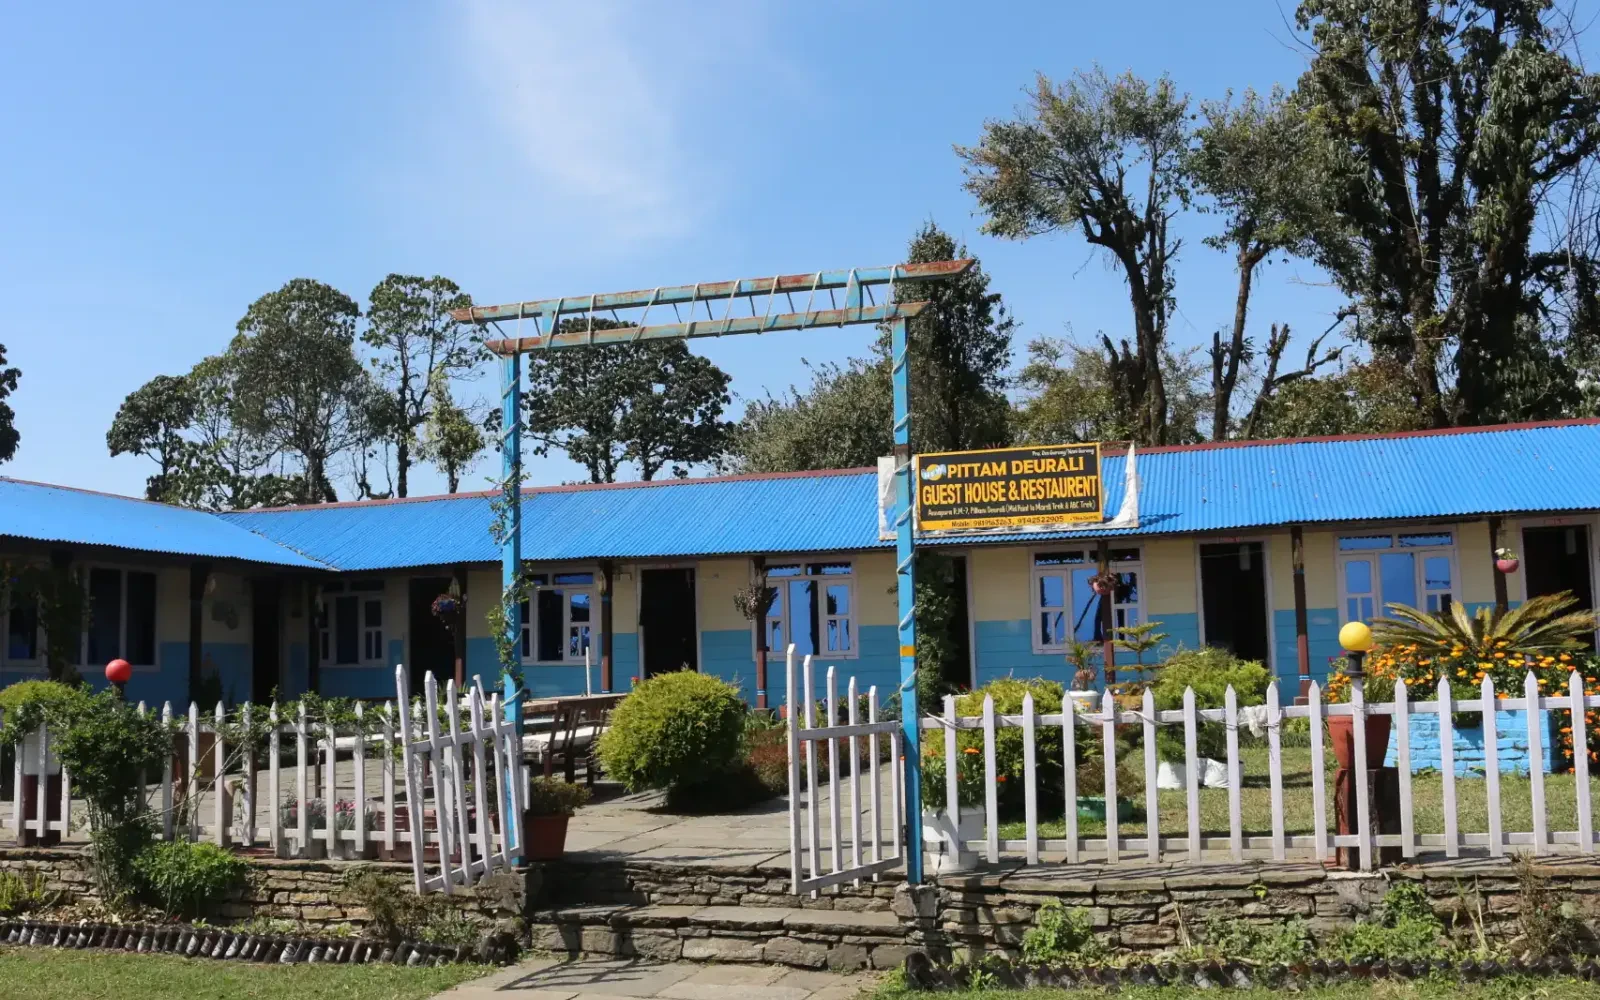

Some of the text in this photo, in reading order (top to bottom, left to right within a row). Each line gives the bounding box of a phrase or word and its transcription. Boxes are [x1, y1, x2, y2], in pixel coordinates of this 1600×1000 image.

[948, 461, 1006, 478] PITTAM
[1011, 456, 1084, 475] DEURALI
[923, 475, 1097, 505] GUEST HOUSE & RESTAURENT
[1052, 502, 1064, 510] Trek
[1070, 501, 1079, 510] ABC
[1080, 500, 1096, 510] Trek)
